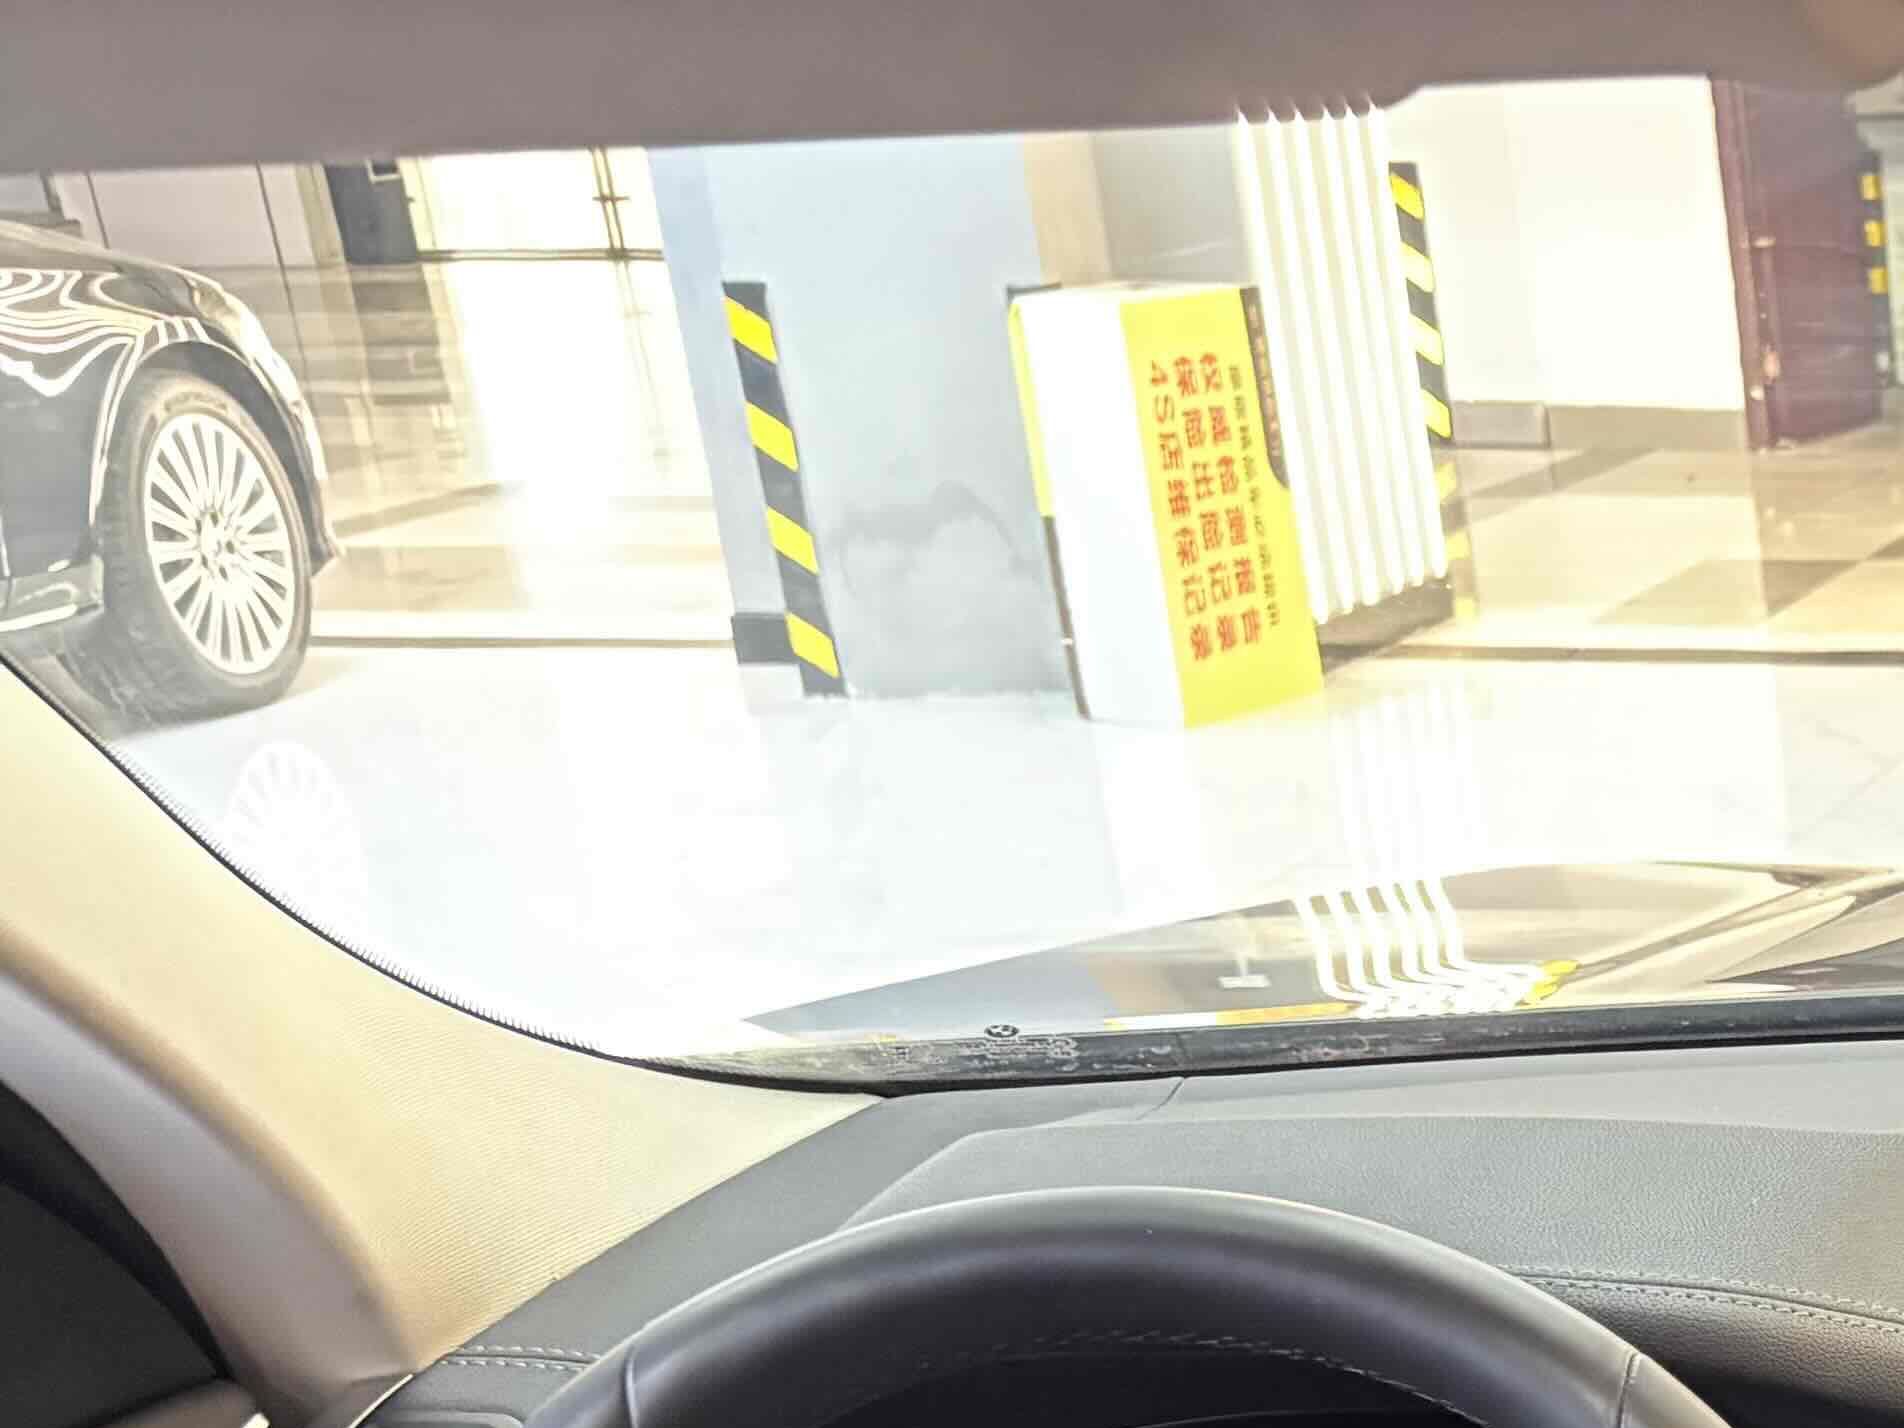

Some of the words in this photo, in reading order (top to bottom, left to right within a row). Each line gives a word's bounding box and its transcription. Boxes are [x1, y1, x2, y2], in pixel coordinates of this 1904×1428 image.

[1148, 361, 1212, 662] 4S店维保记录
[1173, 356, 1238, 651] 保险出险记录
